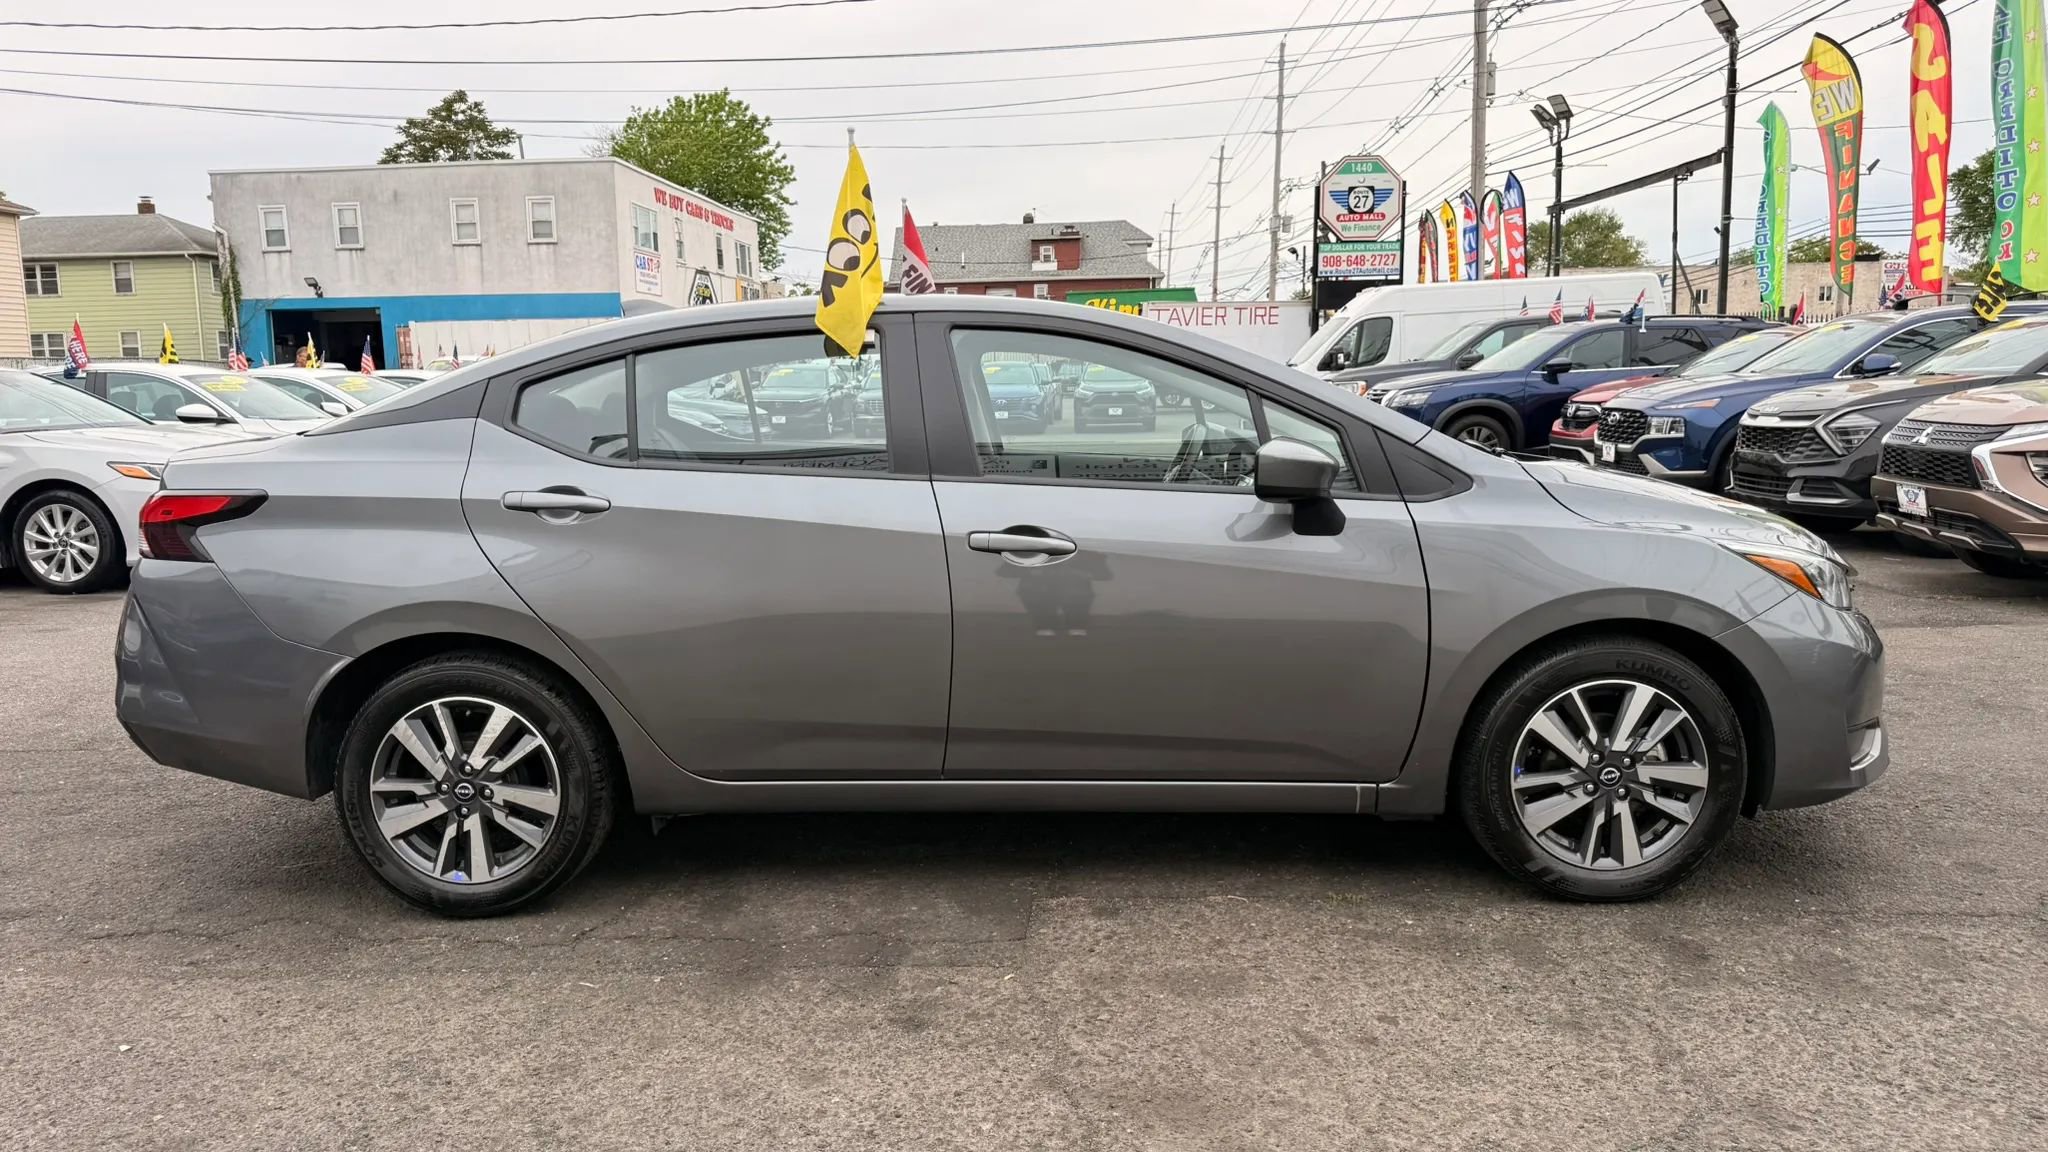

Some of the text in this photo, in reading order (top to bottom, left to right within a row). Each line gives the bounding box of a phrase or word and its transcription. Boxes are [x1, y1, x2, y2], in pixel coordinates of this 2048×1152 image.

[1351, 162, 1373, 173] 1440
[653, 187, 667, 206] WE
[669, 193, 685, 212] BUY
[686, 200, 704, 220] CARS
[710, 209, 734, 232] TRUCKS
[1353, 195, 1369, 209] 27
[1341, 223, 1382, 232] We Finance
[1322, 253, 1397, 268] 908-648-2727
[1234, 306, 1280, 326] TIRE
[1616, 659, 1691, 692] KUMHO
